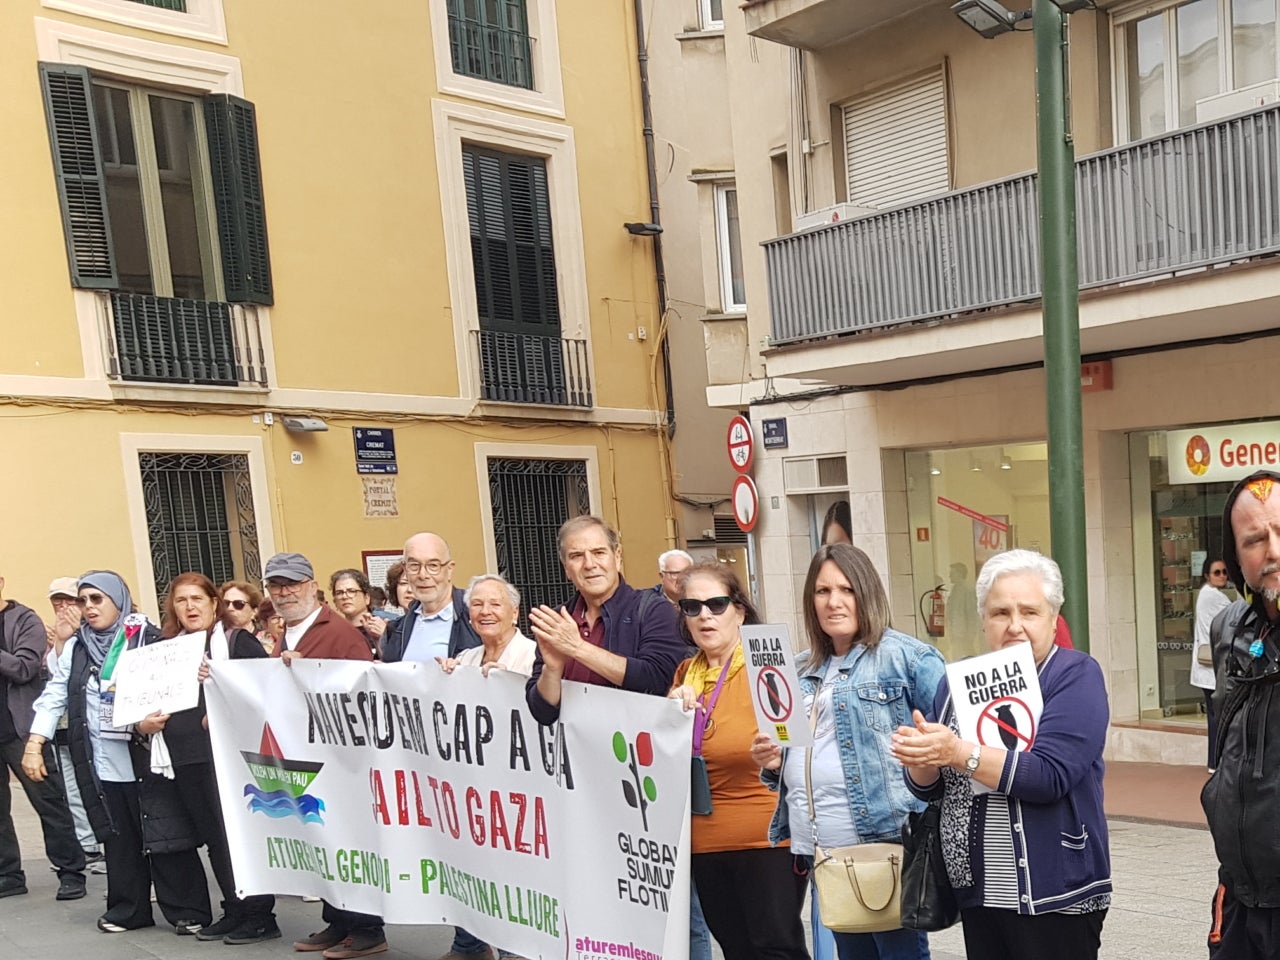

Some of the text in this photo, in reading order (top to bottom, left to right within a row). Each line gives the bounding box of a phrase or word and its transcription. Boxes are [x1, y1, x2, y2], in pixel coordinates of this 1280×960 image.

[371, 499, 391, 507] CREMAT
[749, 636, 782, 652] NO A LA
[751, 651, 786, 668] GUERRA
[964, 660, 1023, 691] NO A LA
[968, 675, 1027, 706] GUERRA
[432, 700, 494, 767] CAP
[510, 709, 531, 772] A
[292, 772, 308, 787] PAU
[427, 775, 460, 840] TO
[466, 785, 550, 860] GAZA
[420, 858, 503, 920] PALESTINA
[504, 884, 560, 939] LLIURE
